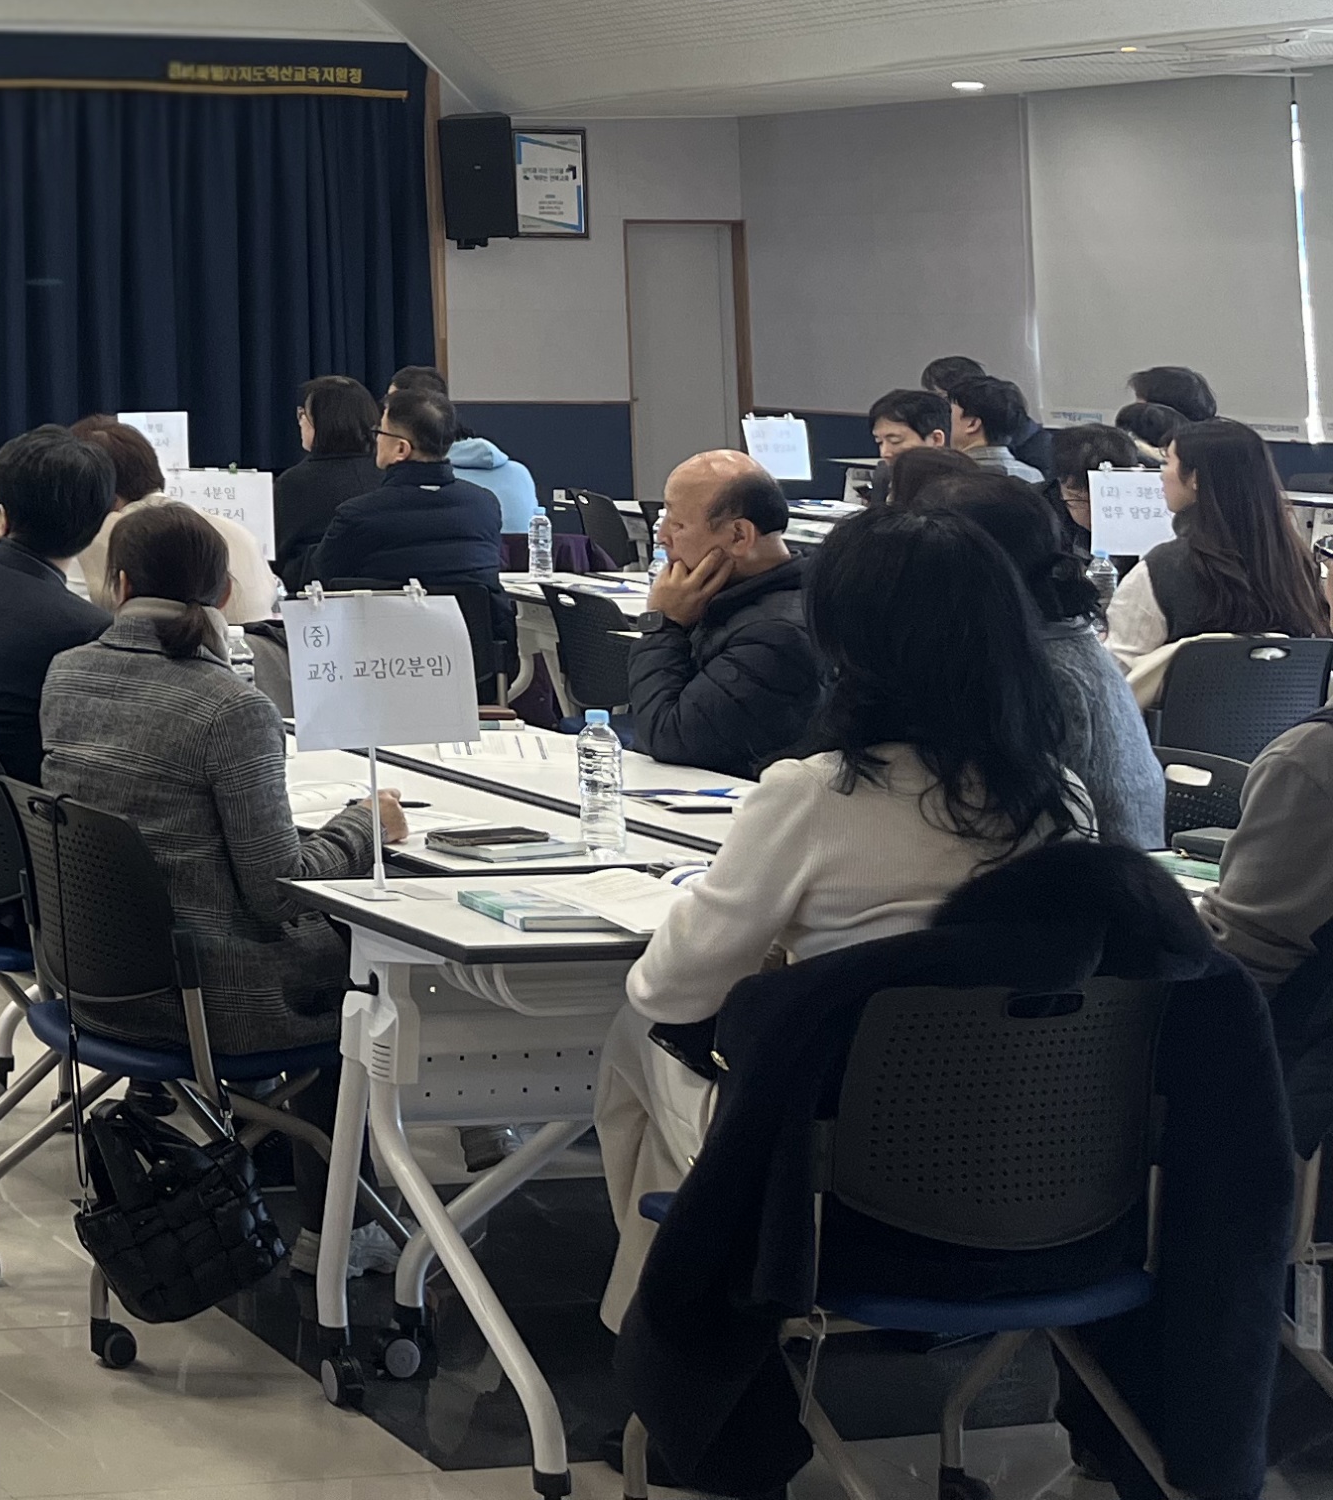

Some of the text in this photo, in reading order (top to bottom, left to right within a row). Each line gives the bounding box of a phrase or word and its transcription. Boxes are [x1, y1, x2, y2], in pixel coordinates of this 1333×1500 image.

[203, 486, 236, 500] 4분임
[302, 625, 330, 648] (중)
[353, 654, 452, 679] 교감(2분임)
